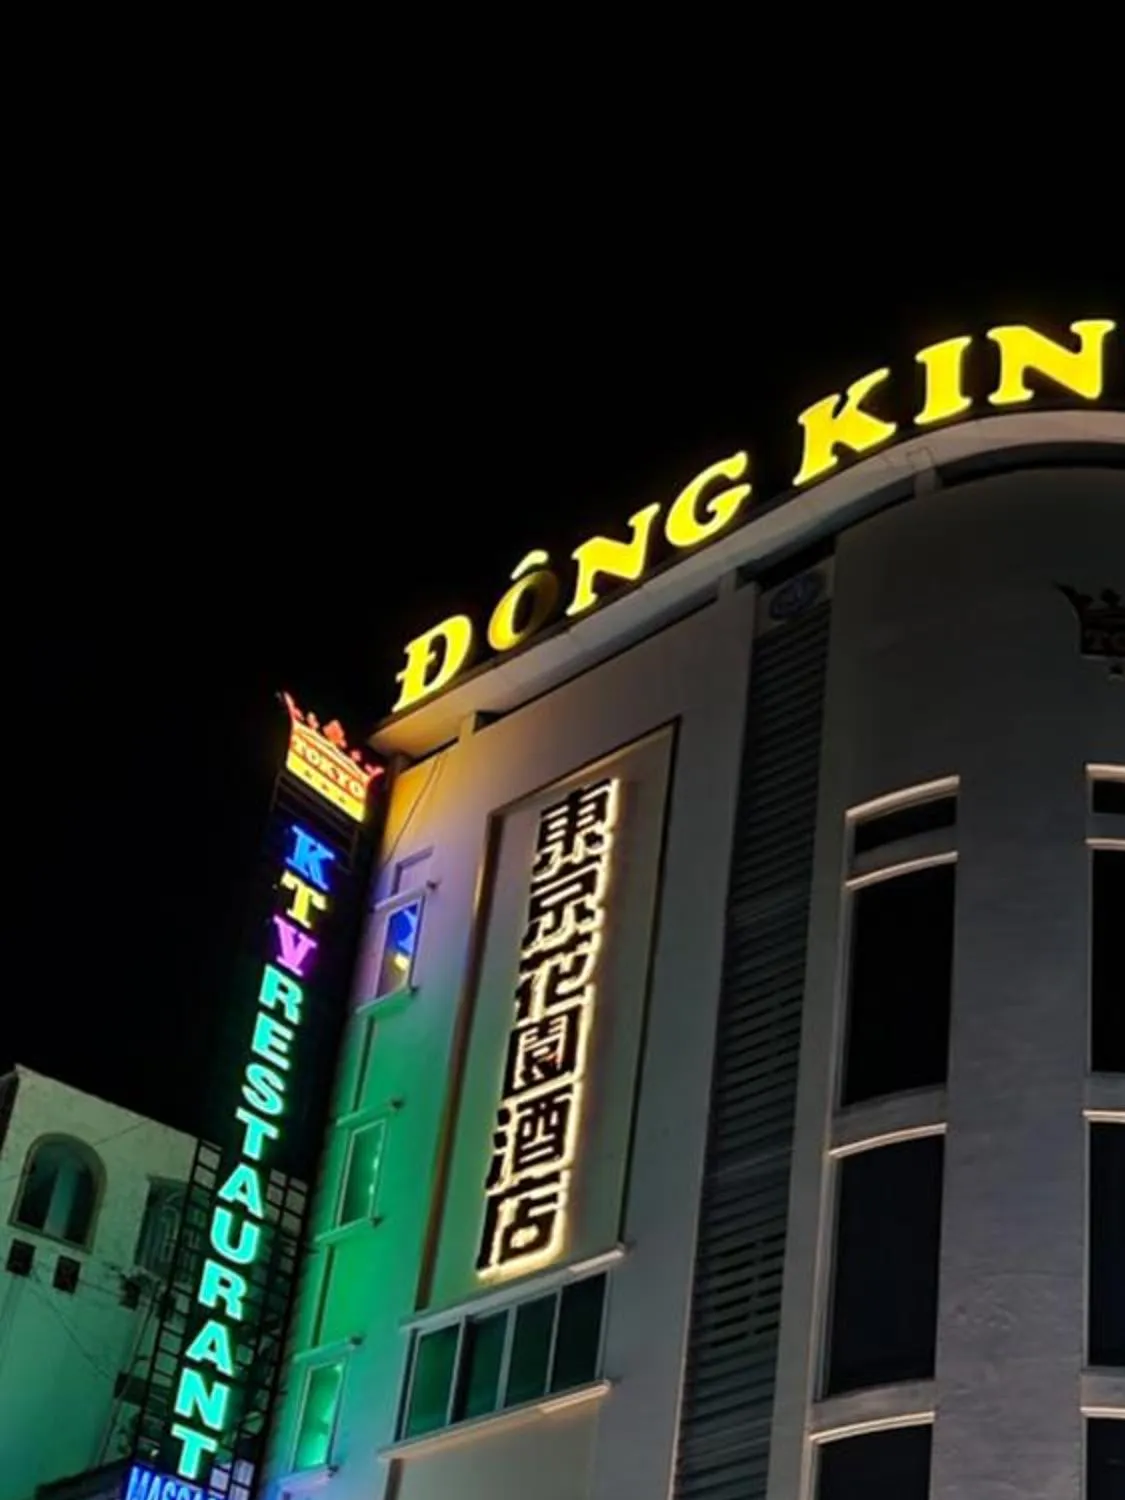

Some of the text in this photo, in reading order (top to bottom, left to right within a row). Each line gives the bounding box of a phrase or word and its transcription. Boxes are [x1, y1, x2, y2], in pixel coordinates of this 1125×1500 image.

[391, 451, 751, 712] ĐÔNG
[290, 731, 367, 800] TOKYO
[170, 963, 304, 1480] RESTAURANT
